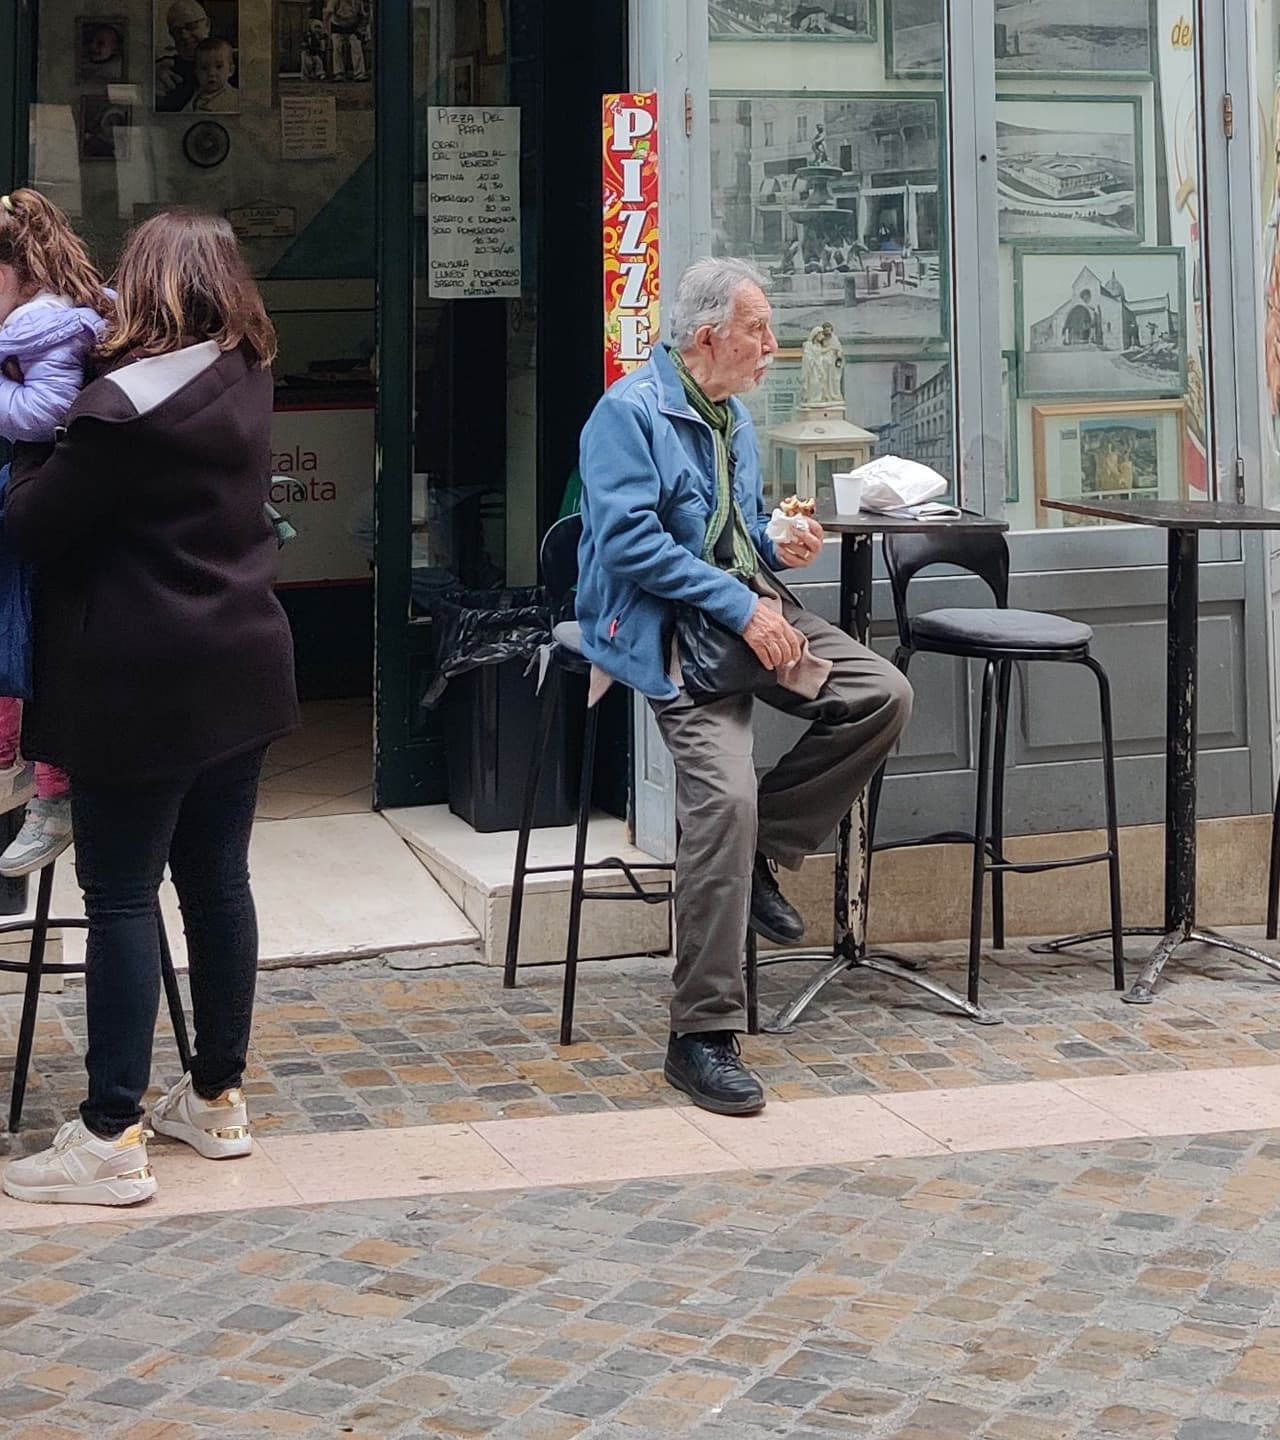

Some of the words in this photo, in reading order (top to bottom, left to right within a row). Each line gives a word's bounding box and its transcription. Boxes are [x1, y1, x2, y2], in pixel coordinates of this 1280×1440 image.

[438, 108, 474, 124] PIZZA
[458, 124, 485, 135] PAPA
[611, 108, 654, 360] PIZZE
